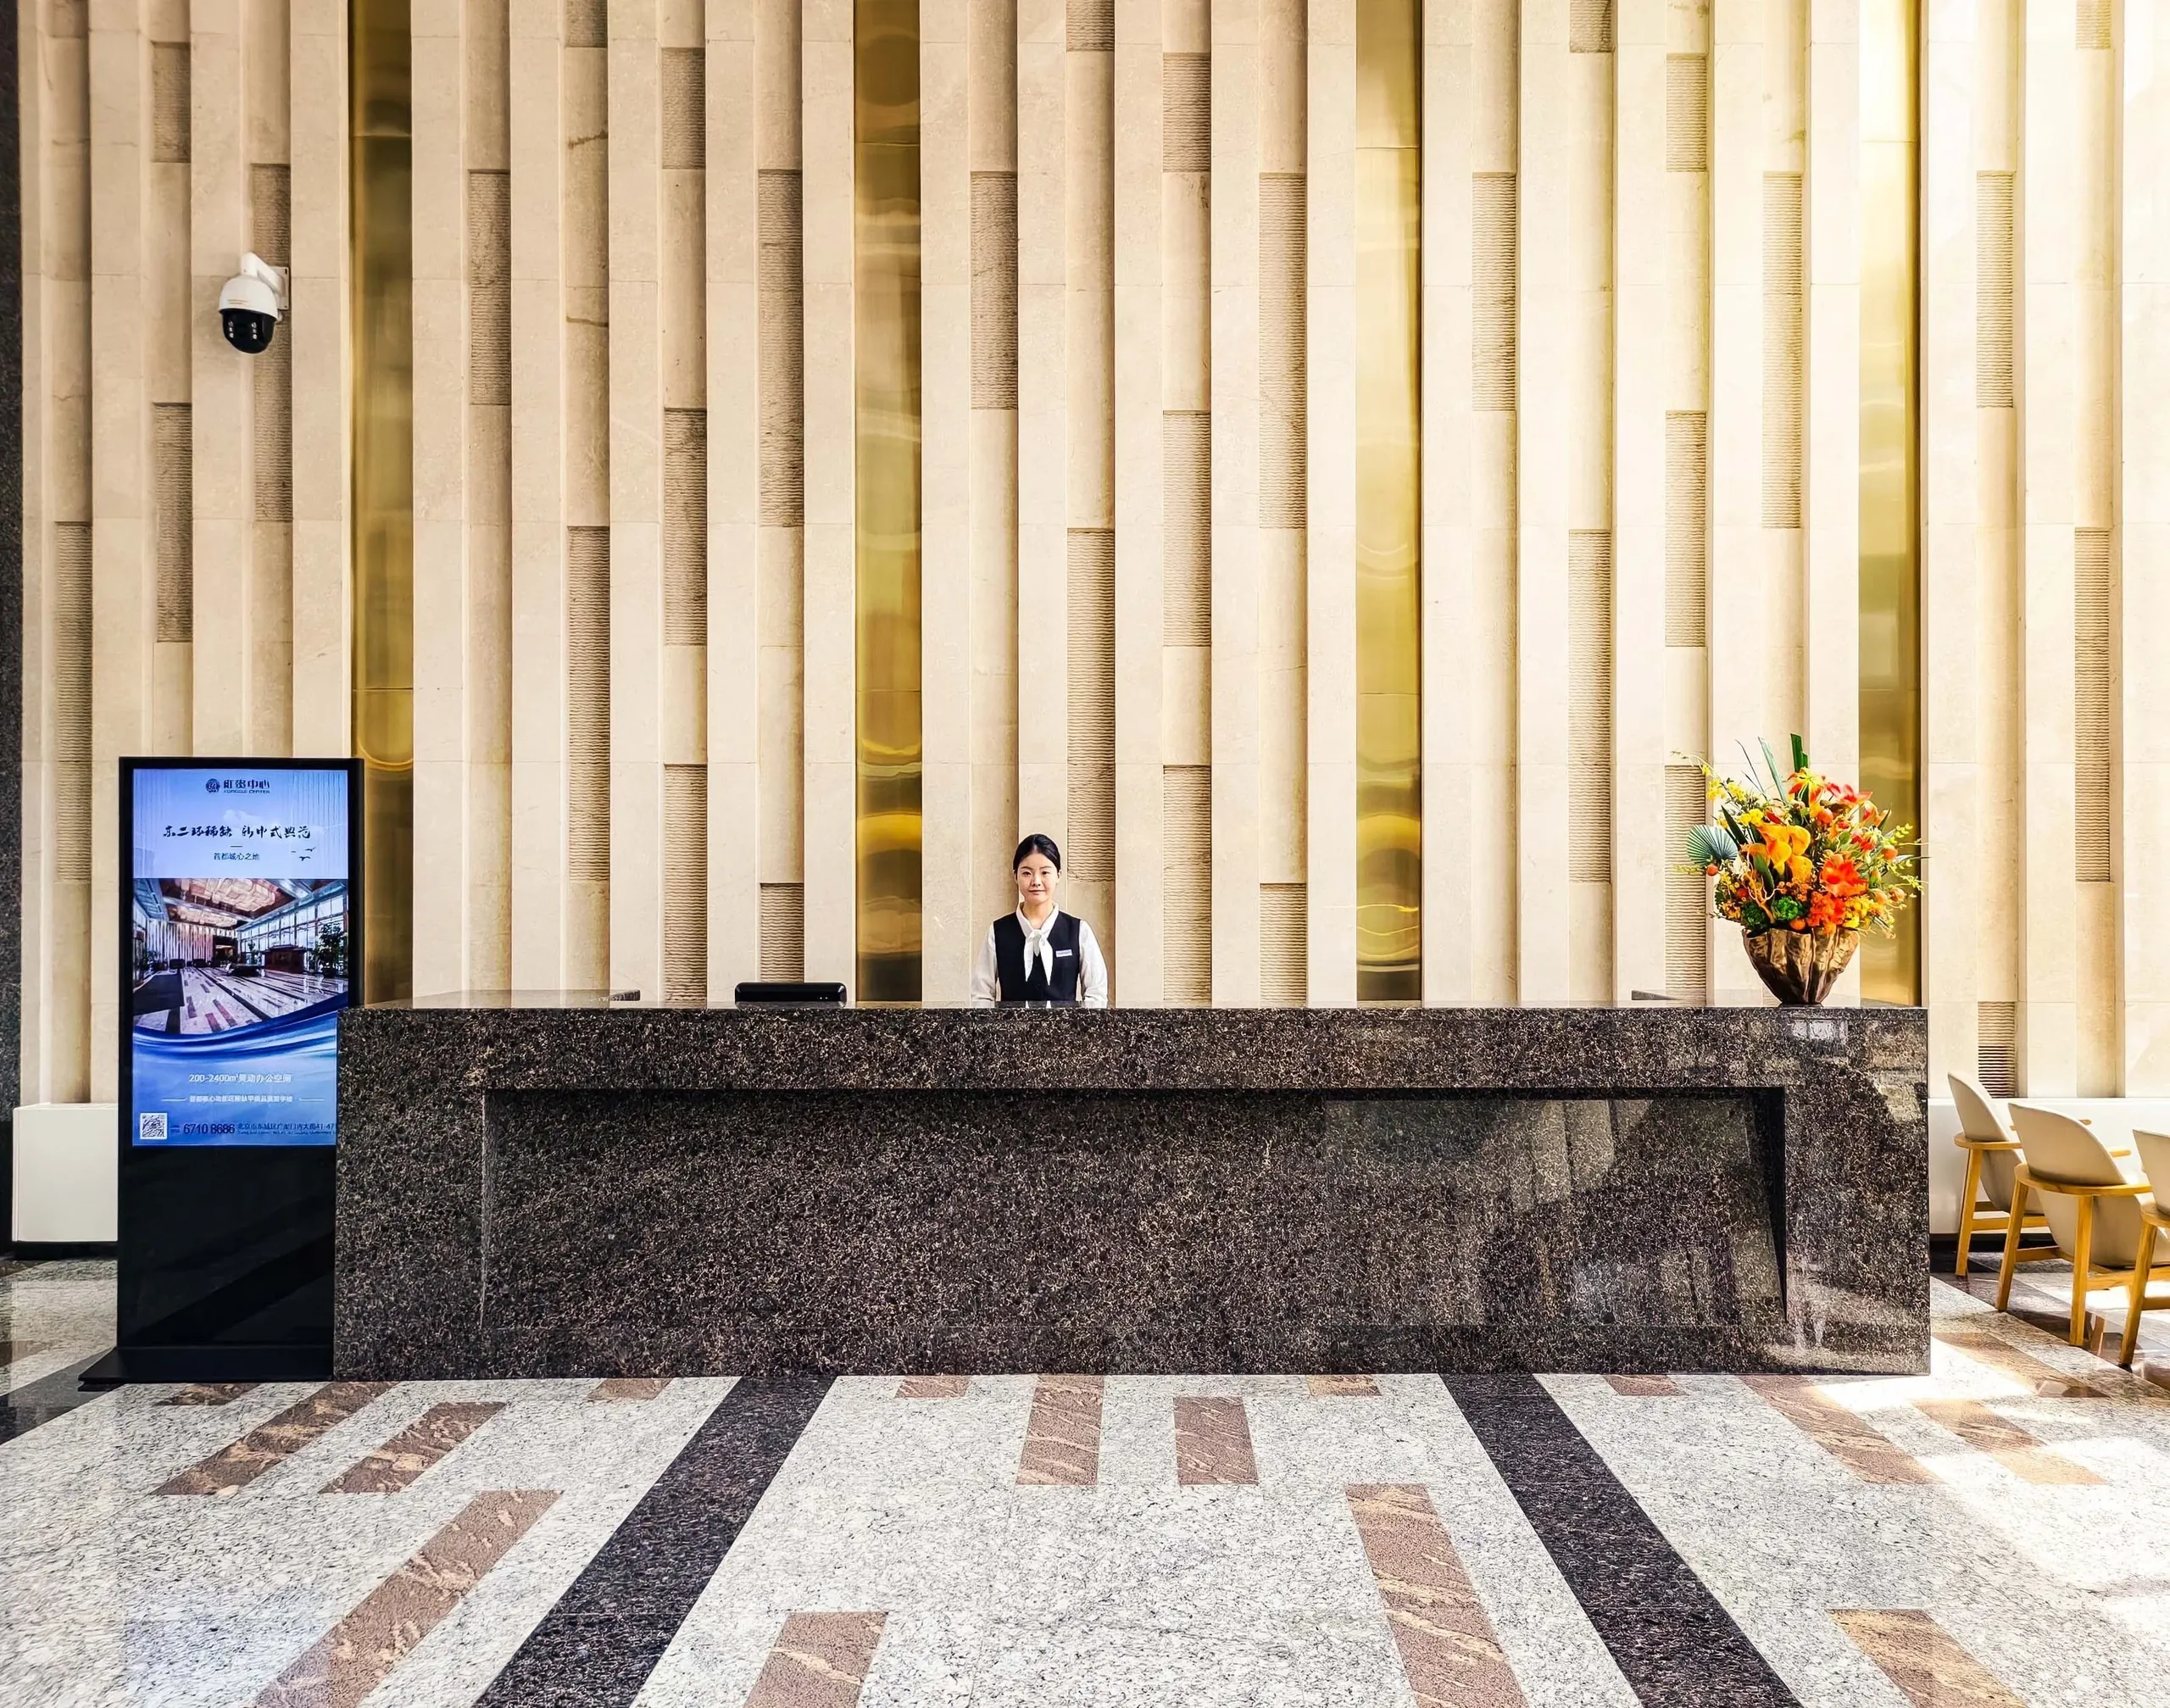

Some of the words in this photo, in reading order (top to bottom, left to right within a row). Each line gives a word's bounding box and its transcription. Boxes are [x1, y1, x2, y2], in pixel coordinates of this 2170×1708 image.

[163, 825, 233, 838] 东二环稀缺
[183, 1123, 209, 1134] 6710
[210, 1123, 236, 1134] 8686
